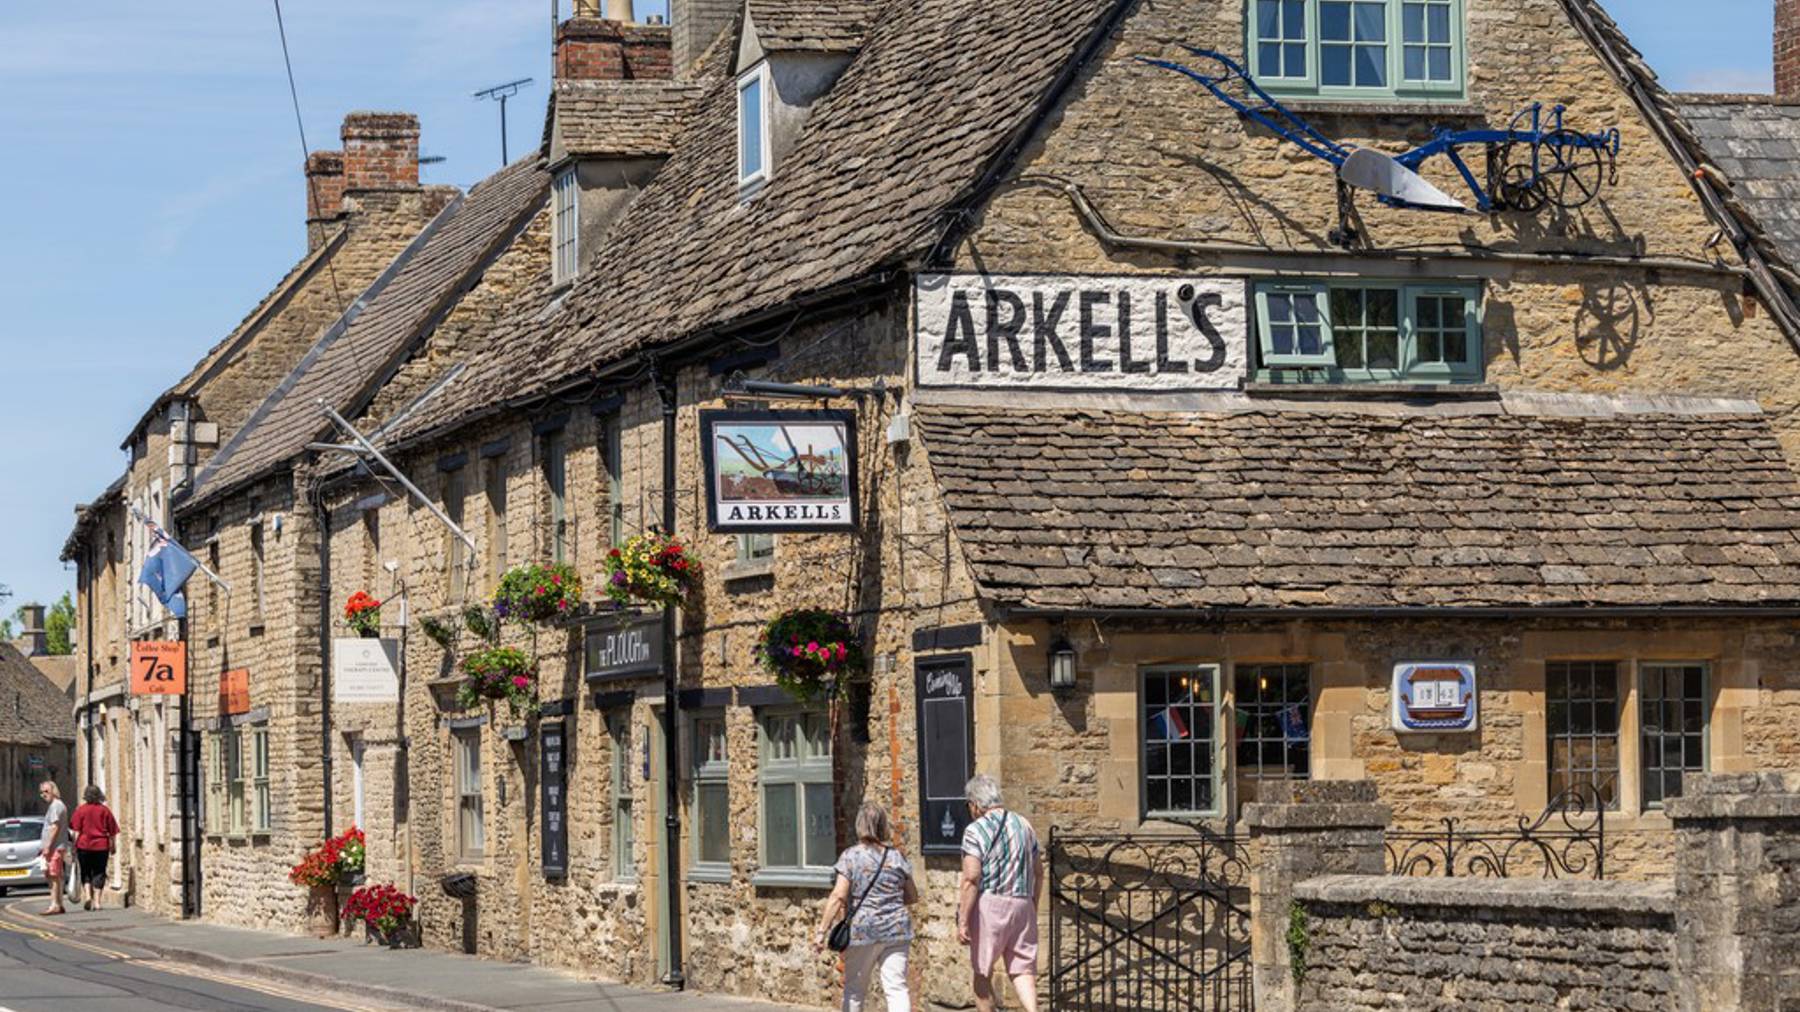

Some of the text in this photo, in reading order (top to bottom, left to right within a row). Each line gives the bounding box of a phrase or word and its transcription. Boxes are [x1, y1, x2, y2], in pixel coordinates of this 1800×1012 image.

[136, 643, 179, 654] Coffee Shop
[606, 630, 642, 666] PLOUGH
[140, 656, 174, 682] 7a
